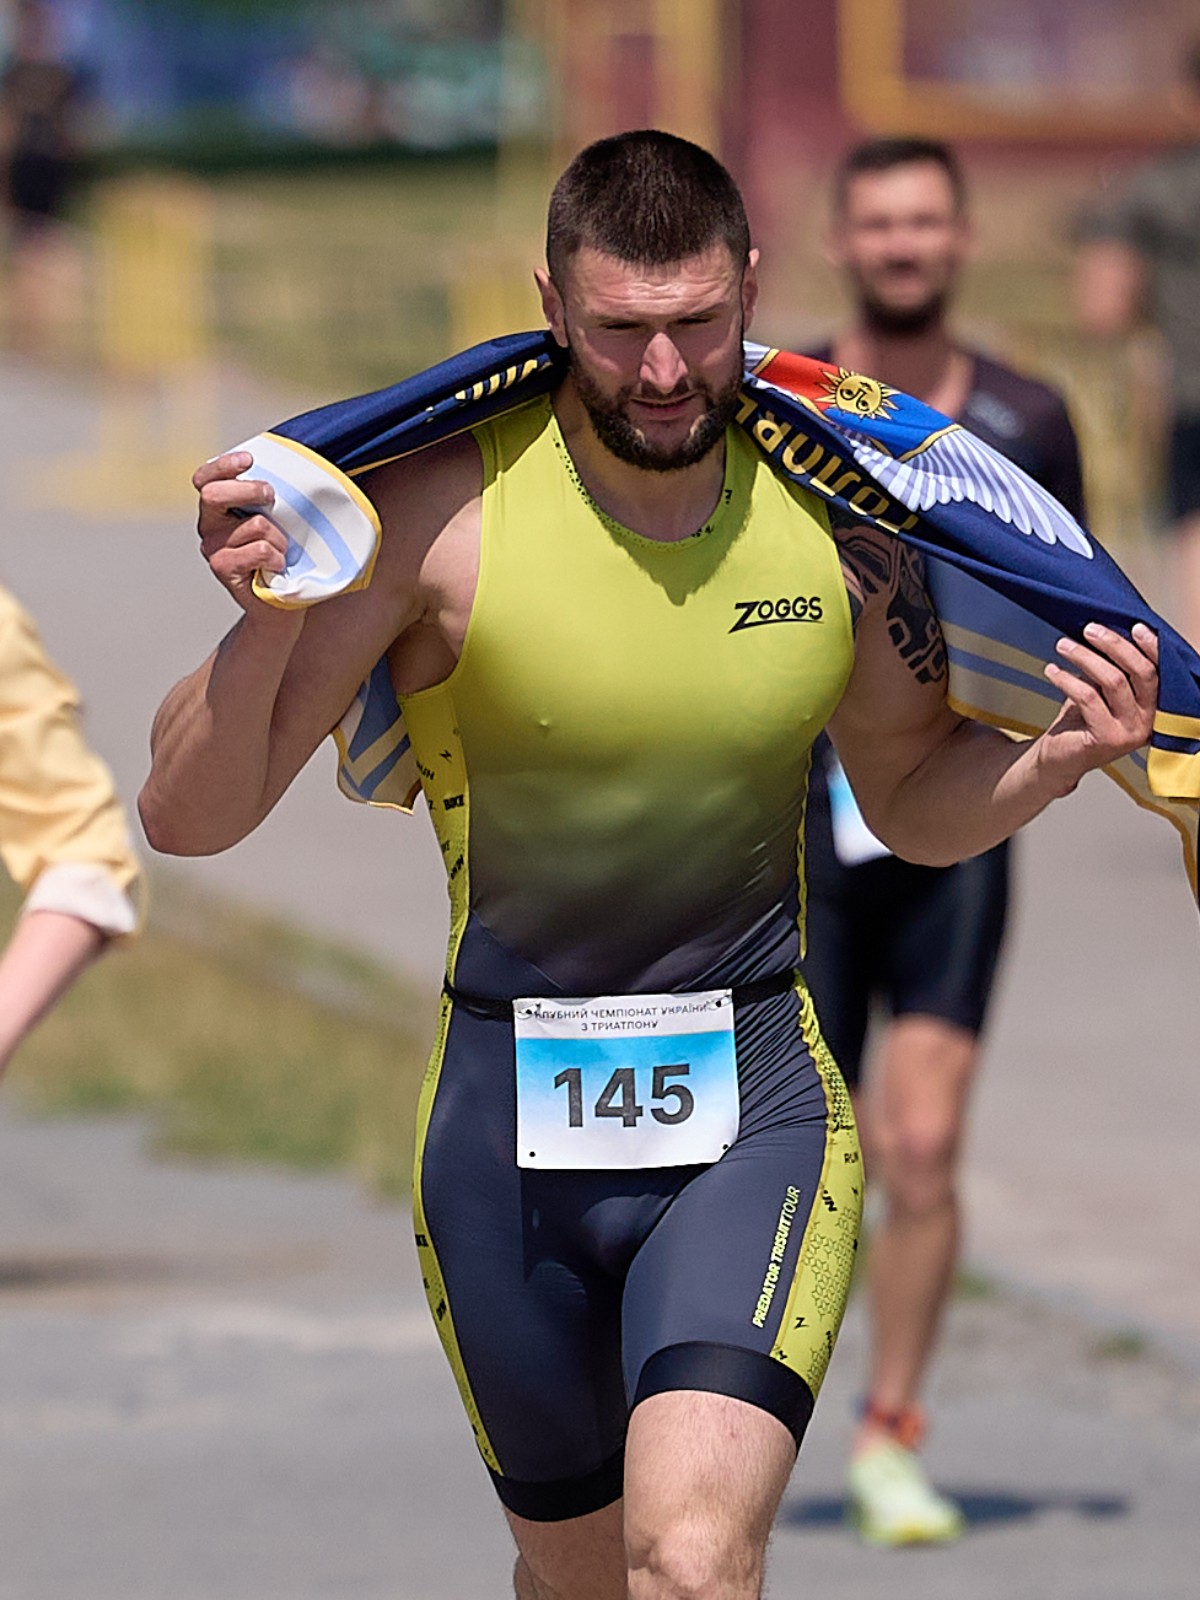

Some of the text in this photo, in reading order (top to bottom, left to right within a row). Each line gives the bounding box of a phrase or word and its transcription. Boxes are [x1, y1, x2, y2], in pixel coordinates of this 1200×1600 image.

[728, 596, 823, 634] ZOGGS
[591, 1007, 656, 1019] ЧЕМПІОНАТ
[591, 1020, 658, 1031] ТРИАТЛОНУ
[554, 1063, 694, 1128] 145
[752, 1262, 781, 1328] PREDATOR
